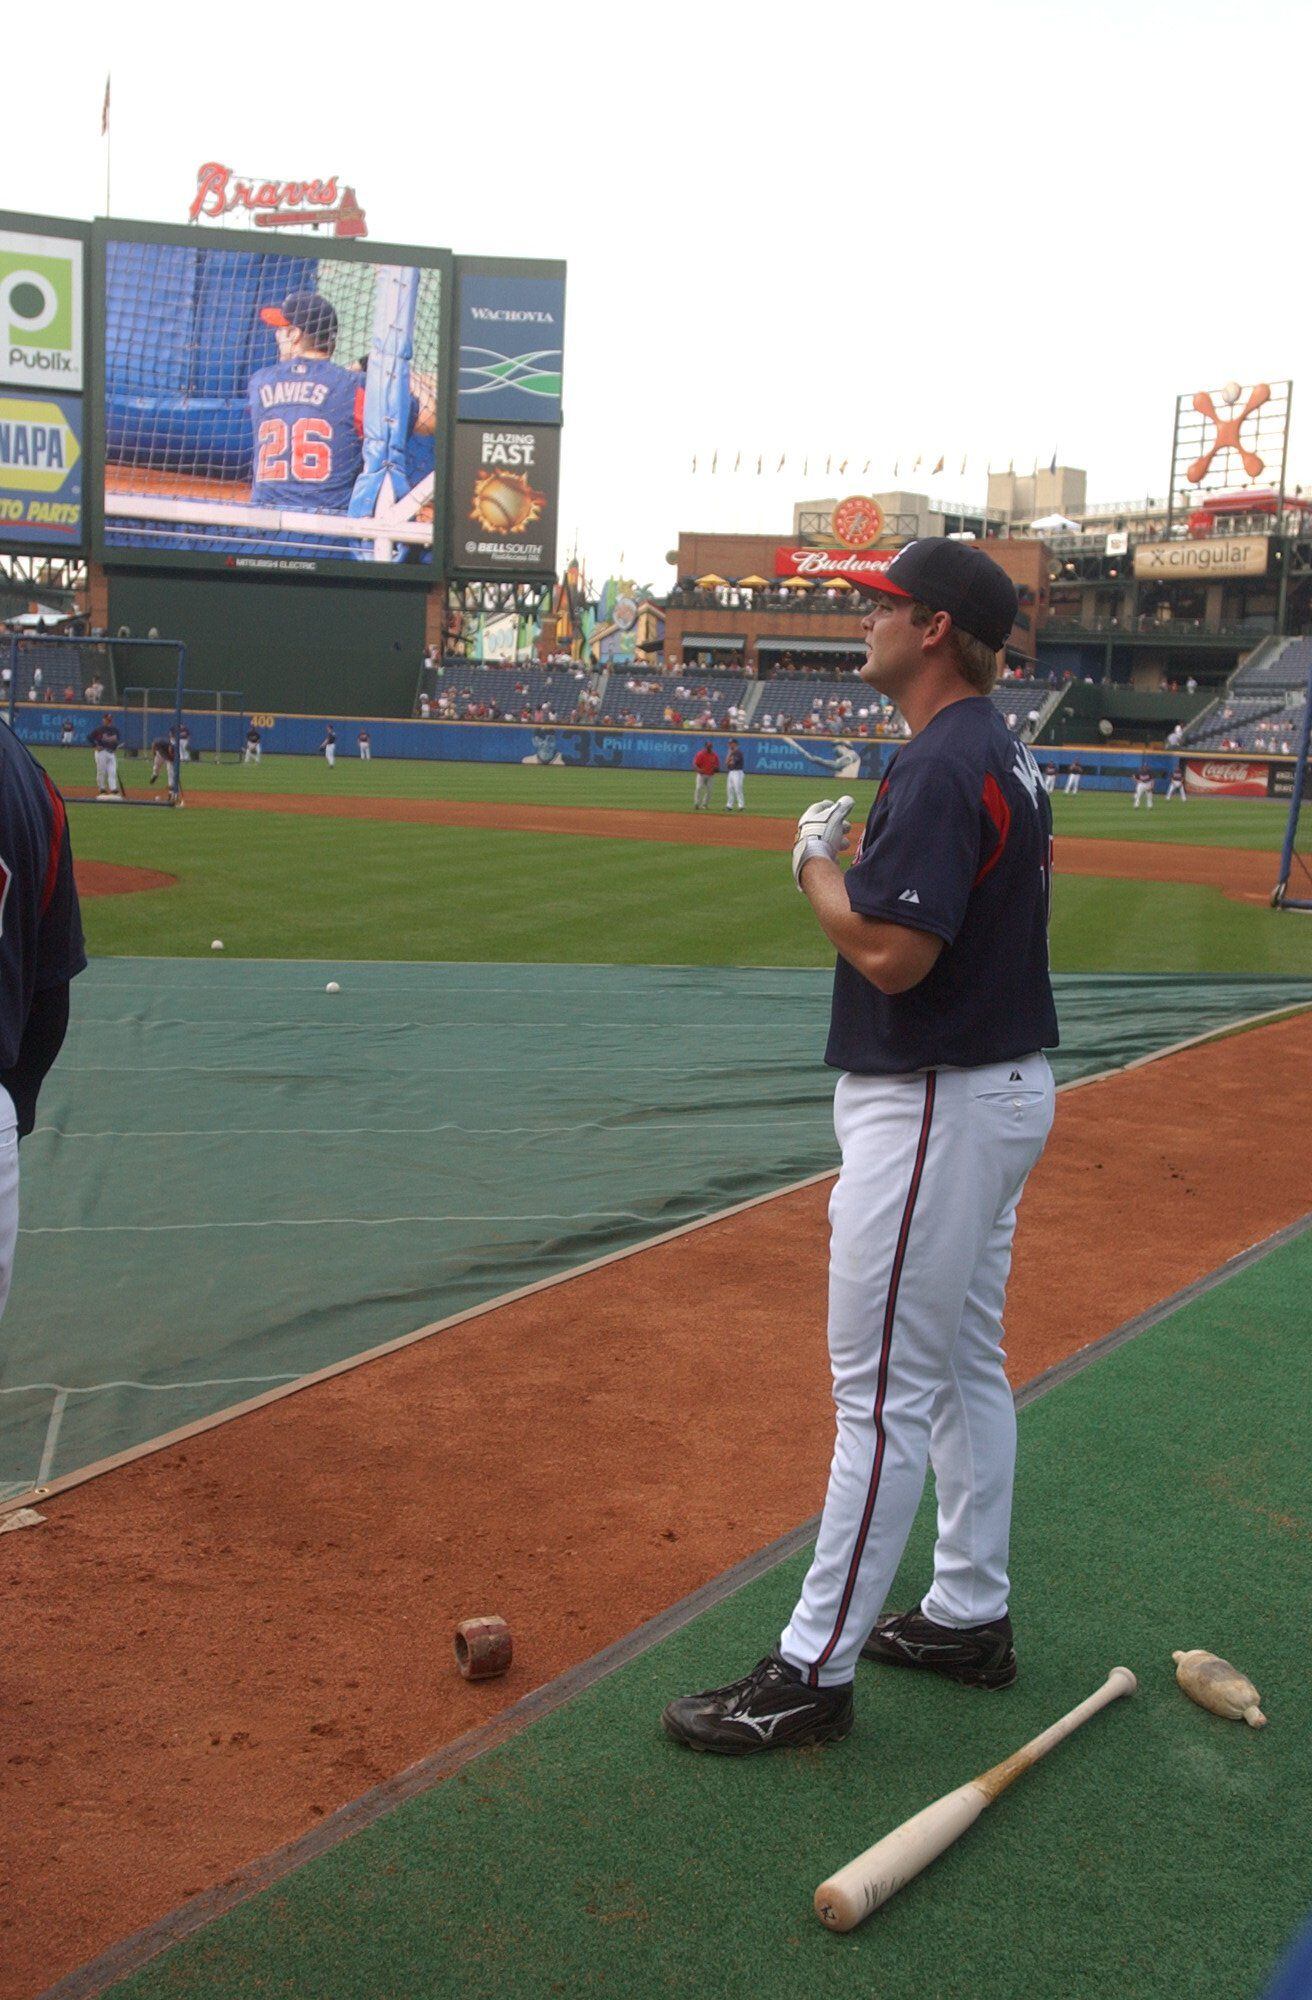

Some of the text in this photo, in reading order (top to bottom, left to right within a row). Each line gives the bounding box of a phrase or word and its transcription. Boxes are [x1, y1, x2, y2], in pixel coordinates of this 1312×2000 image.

[190, 162, 339, 217] Braves
[470, 306, 554, 323] WACHOVIA
[9, 348, 71, 371] Publix
[261, 381, 329, 408] DAVIES
[482, 432, 535, 444] BLAZING
[256, 418, 333, 482] 26
[26, 501, 80, 523] PARTS
[477, 542, 543, 554] BELLSOUTH
[1169, 543, 1250, 570] cingular
[250, 714, 275, 728] 400
[602, 737, 689, 754] Phil Niekro
[755, 756, 805, 771] Aaron
